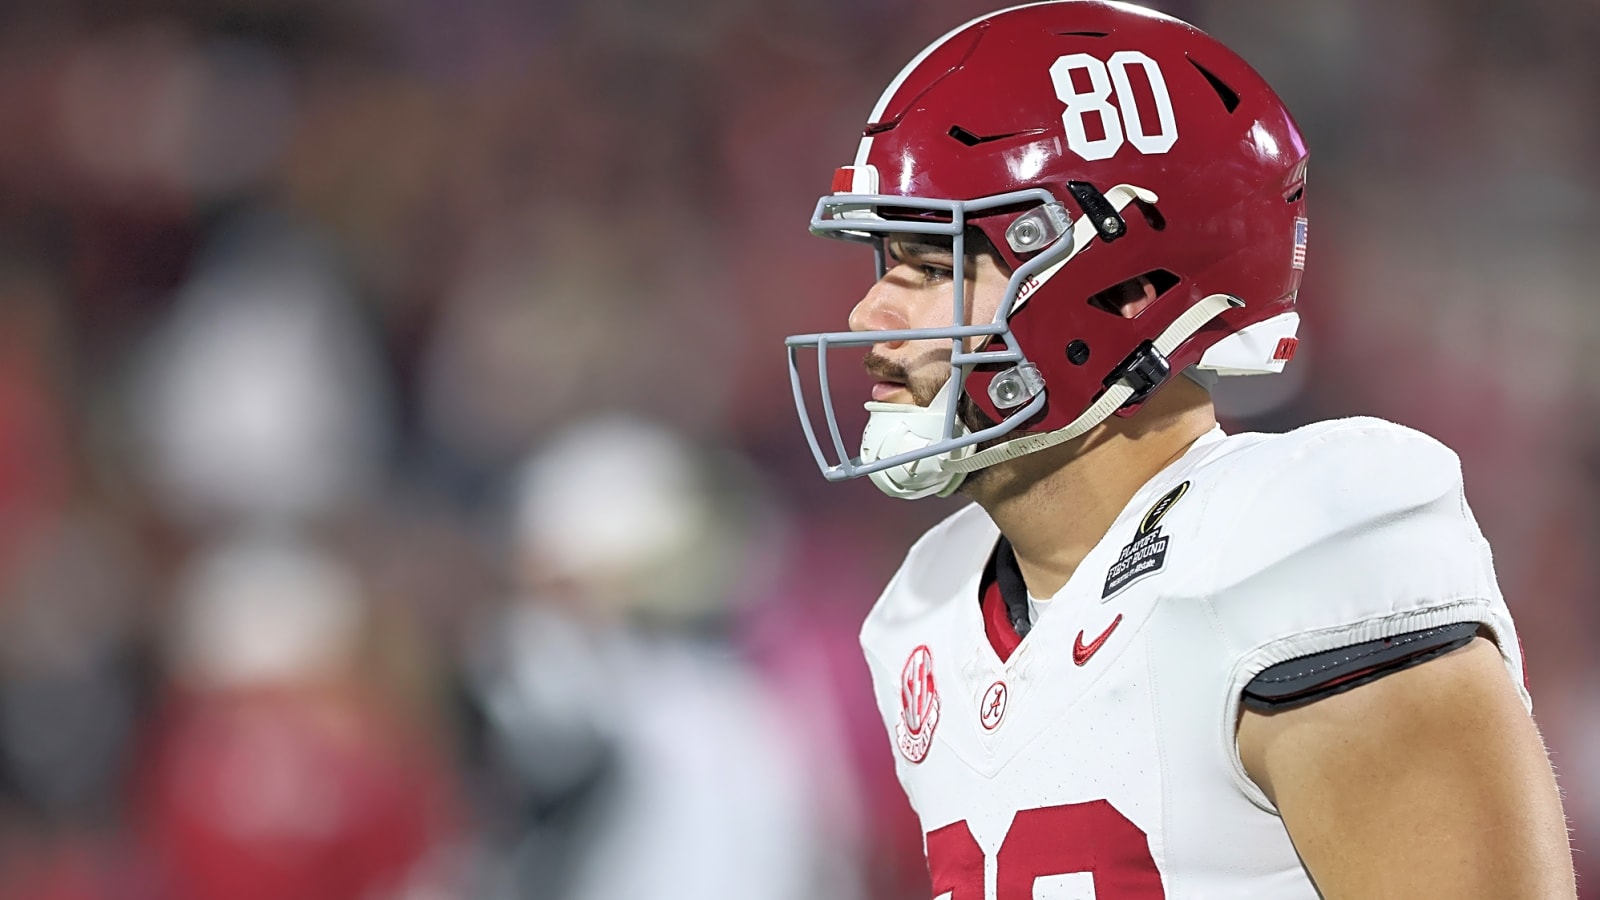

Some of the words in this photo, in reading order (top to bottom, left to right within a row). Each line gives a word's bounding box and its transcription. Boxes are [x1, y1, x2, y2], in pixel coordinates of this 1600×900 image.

[1049, 50, 1178, 161] 80
[1107, 556, 1133, 581] FIRST
[1131, 539, 1167, 566] ROUND
